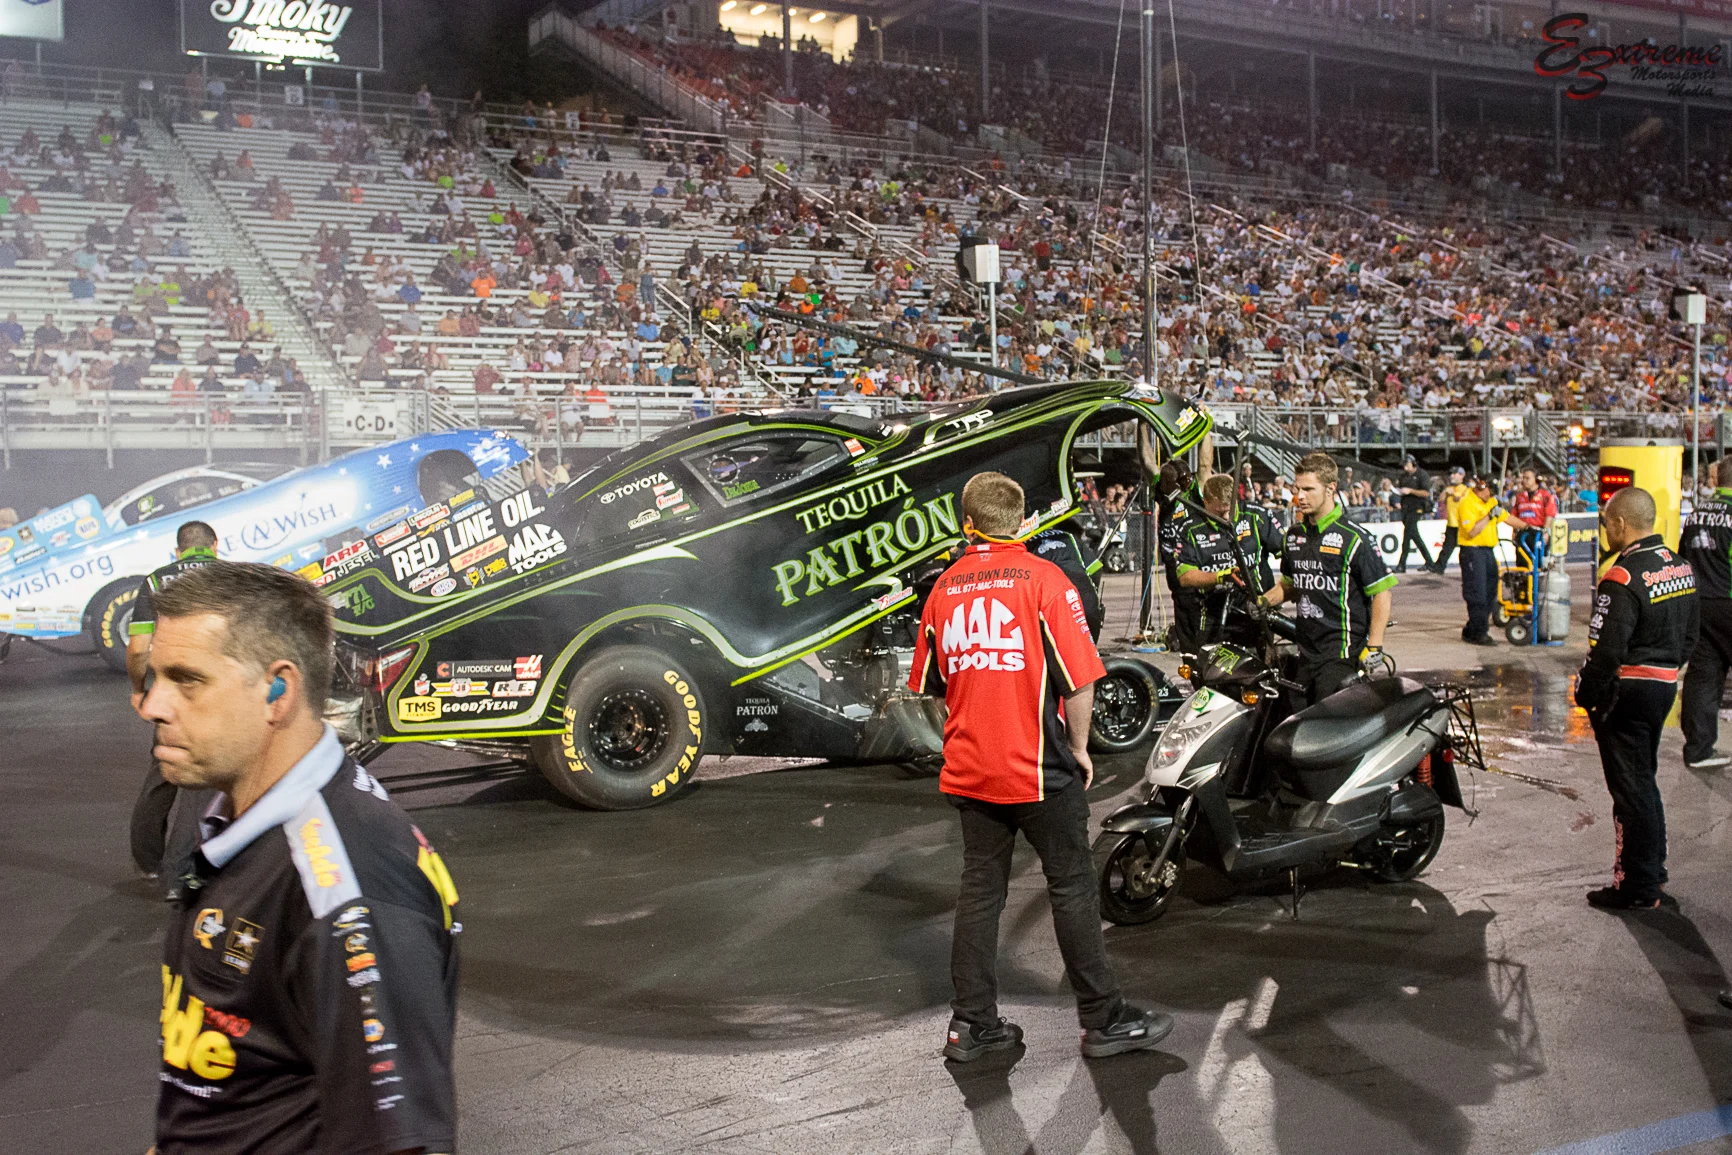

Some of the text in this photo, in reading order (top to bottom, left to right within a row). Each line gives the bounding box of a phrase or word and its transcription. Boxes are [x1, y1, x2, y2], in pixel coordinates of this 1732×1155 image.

[614, 472, 669, 498] TOYOTA
[796, 473, 912, 534] TEQUILA
[273, 503, 337, 533] WISH
[391, 537, 440, 581] RED
[443, 508, 497, 556] LINE
[501, 490, 541, 527] OIL
[508, 523, 565, 566] MAC
[325, 541, 365, 567] ARP
[460, 542, 499, 566] DHL
[512, 541, 567, 574] TOOLS
[771, 492, 960, 607] PATRÓN
[0, 554, 115, 601] wish.org
[951, 573, 975, 586] YOUR
[977, 569, 1001, 581] OWN
[1002, 568, 1031, 580] BOSS
[1294, 560, 1323, 571] TEQUILA
[947, 580, 1014, 596] CALL 877-MAC-TOOLS
[1293, 571, 1338, 591] ATRÓN
[942, 597, 1024, 654] MAC
[457, 664, 512, 673] AUTODESK CAM
[948, 651, 1026, 674] TOOLS
[405, 701, 436, 713] TMS
[442, 698, 518, 714] GOODYEAR
[736, 704, 778, 716] PATRÓN
[561, 705, 586, 772] EAGLE
[651, 670, 702, 797] GOODYEAR
